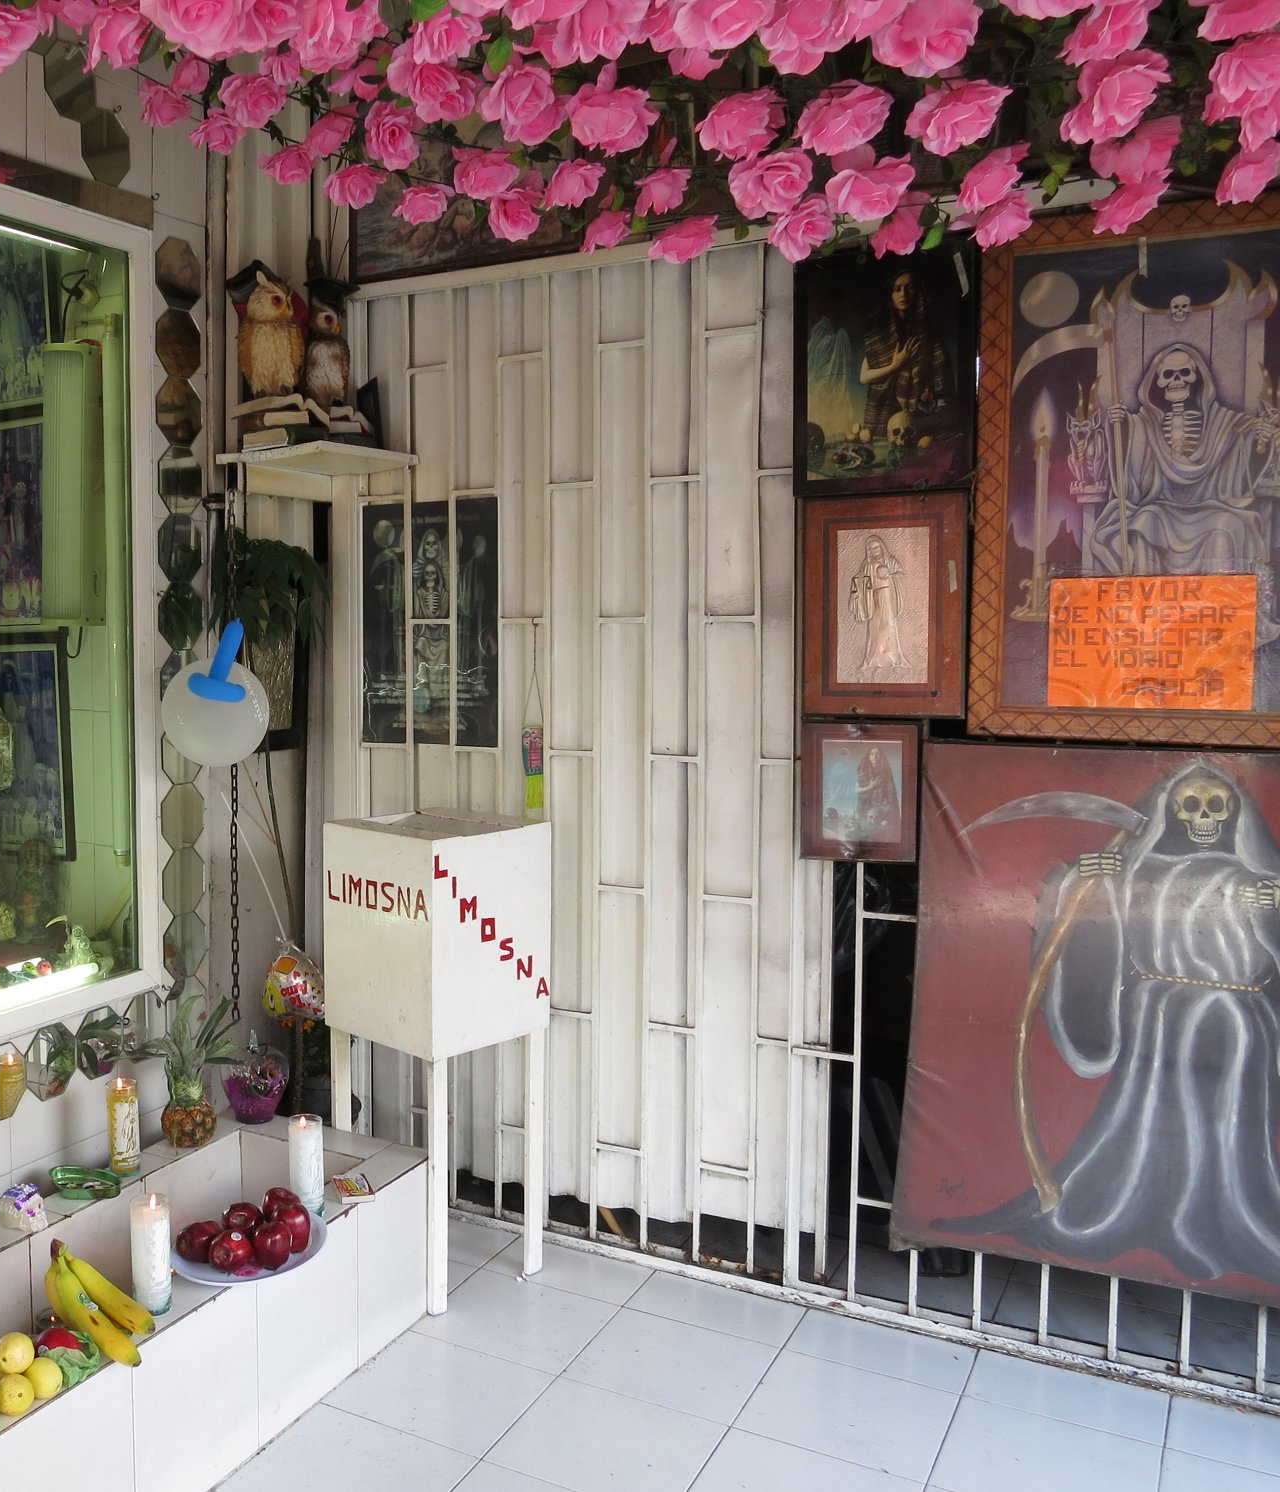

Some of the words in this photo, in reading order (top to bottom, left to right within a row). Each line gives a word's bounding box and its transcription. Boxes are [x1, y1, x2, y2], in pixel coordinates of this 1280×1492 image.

[1096, 580, 1203, 602] FAVOR
[1054, 605, 1089, 625] DE
[1095, 605, 1133, 624] NO
[1142, 604, 1238, 624] PEGAR
[1052, 627, 1077, 646] NI
[1084, 627, 1224, 647] ENSUCIAR
[1052, 649, 1087, 668] EL
[1095, 649, 1183, 669] VIDRIO
[327, 870, 429, 922] LIMOSNA
[433, 854, 550, 999] LIMOSNA
